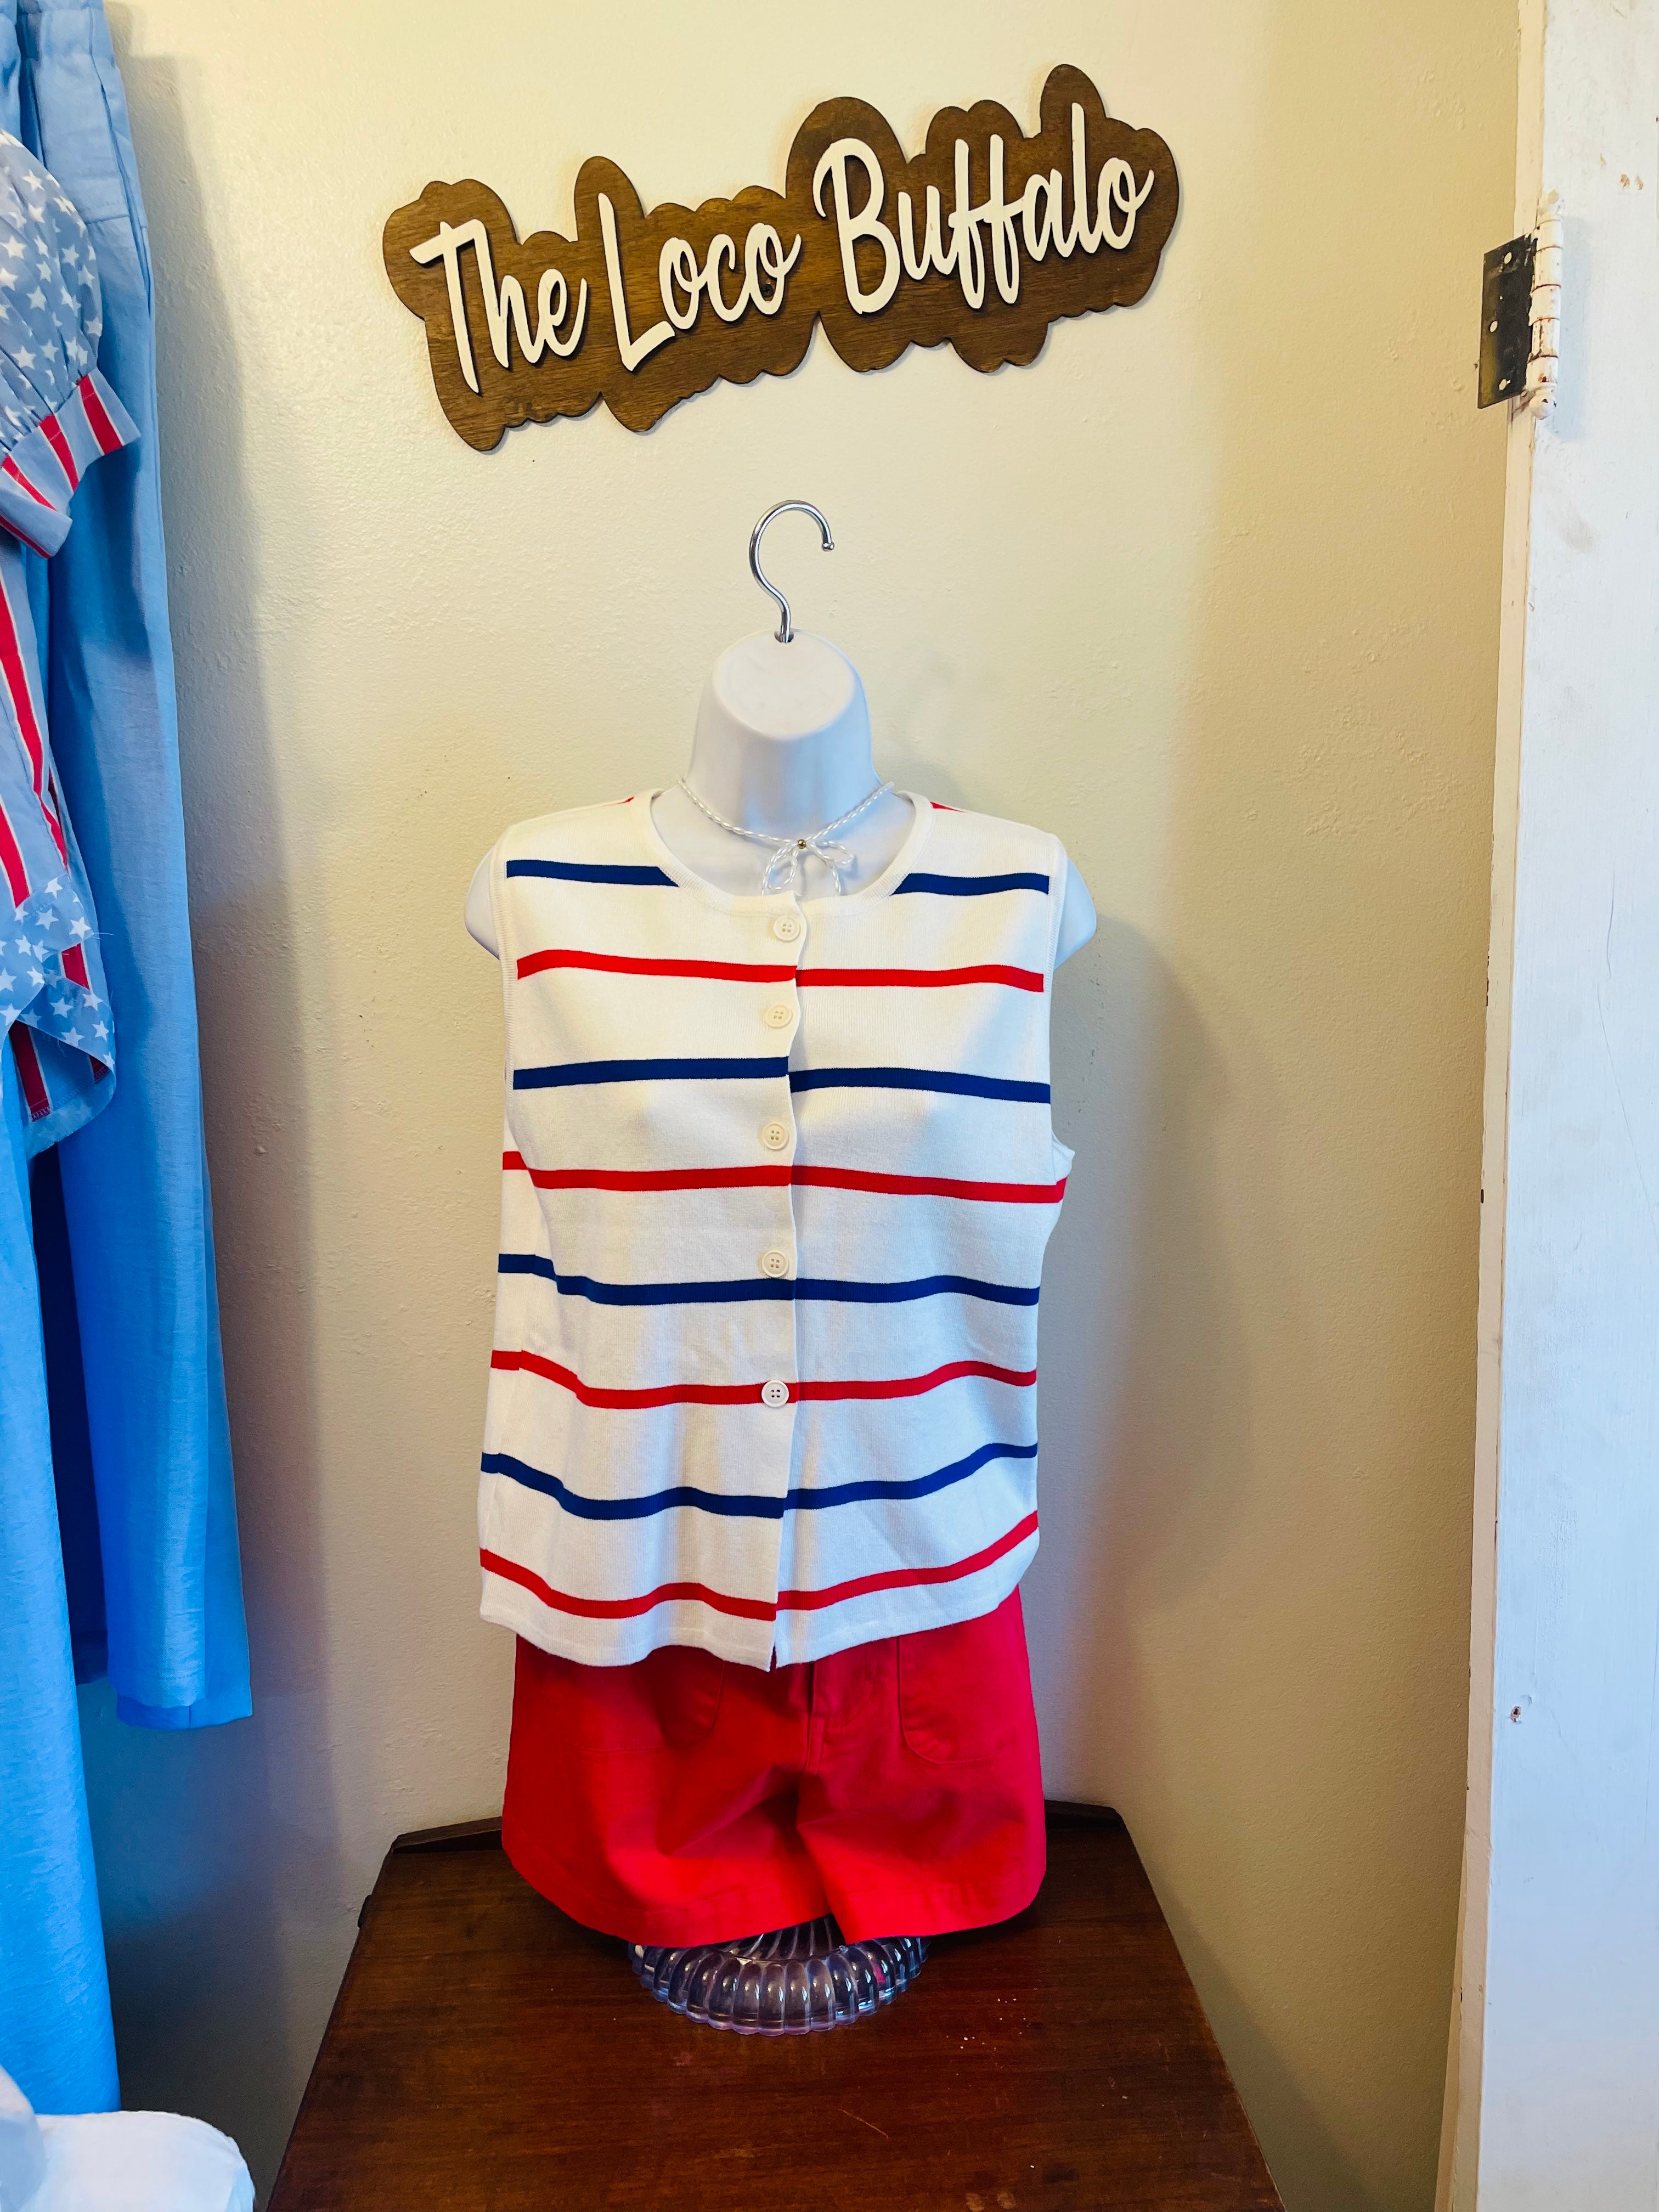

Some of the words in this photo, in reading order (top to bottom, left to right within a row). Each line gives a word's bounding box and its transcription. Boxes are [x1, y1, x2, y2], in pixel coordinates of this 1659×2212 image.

[409, 218, 588, 393] The
[598, 193, 802, 371] Loco
[812, 103, 1155, 315] Buffalo
